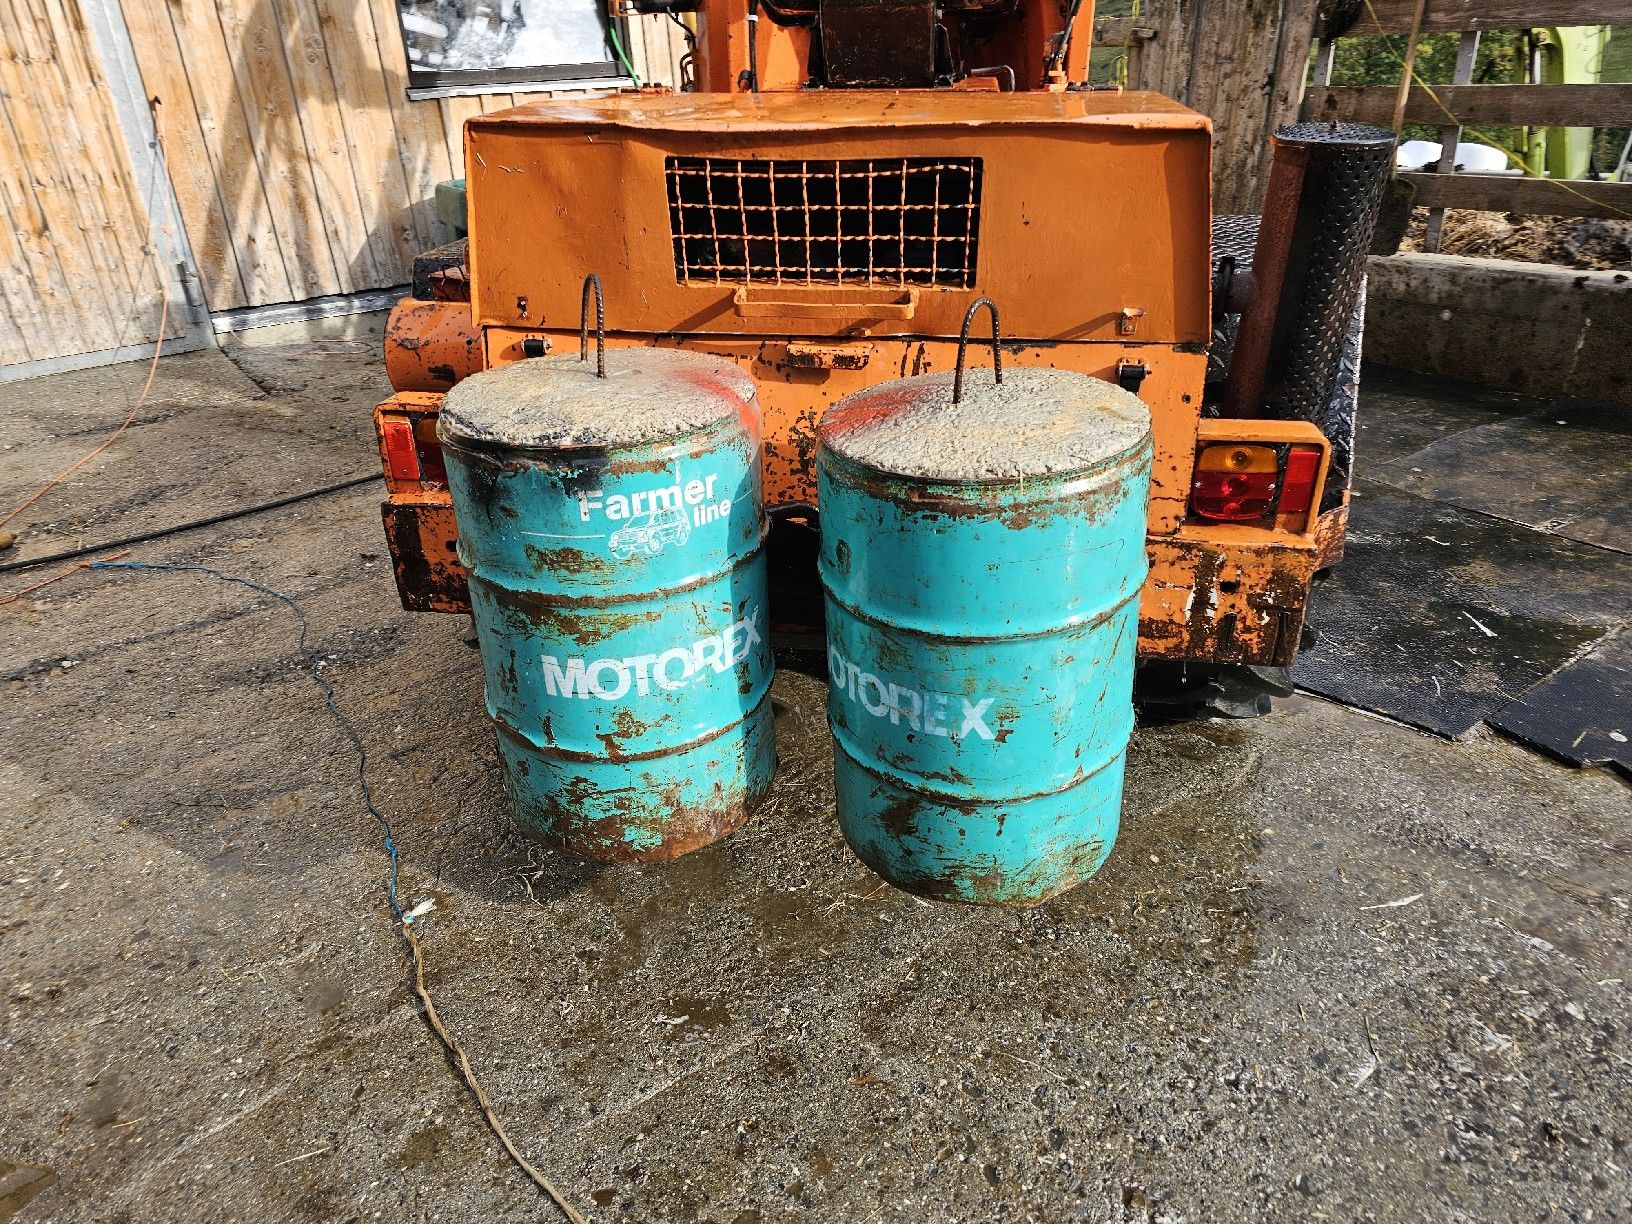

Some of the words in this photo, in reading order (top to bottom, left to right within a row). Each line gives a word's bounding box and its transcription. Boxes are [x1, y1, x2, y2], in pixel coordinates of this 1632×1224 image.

[578, 473, 718, 522] Farmer
[693, 498, 732, 528] line
[540, 604, 762, 701] MOTOREX
[827, 634, 995, 740] OTOREX
